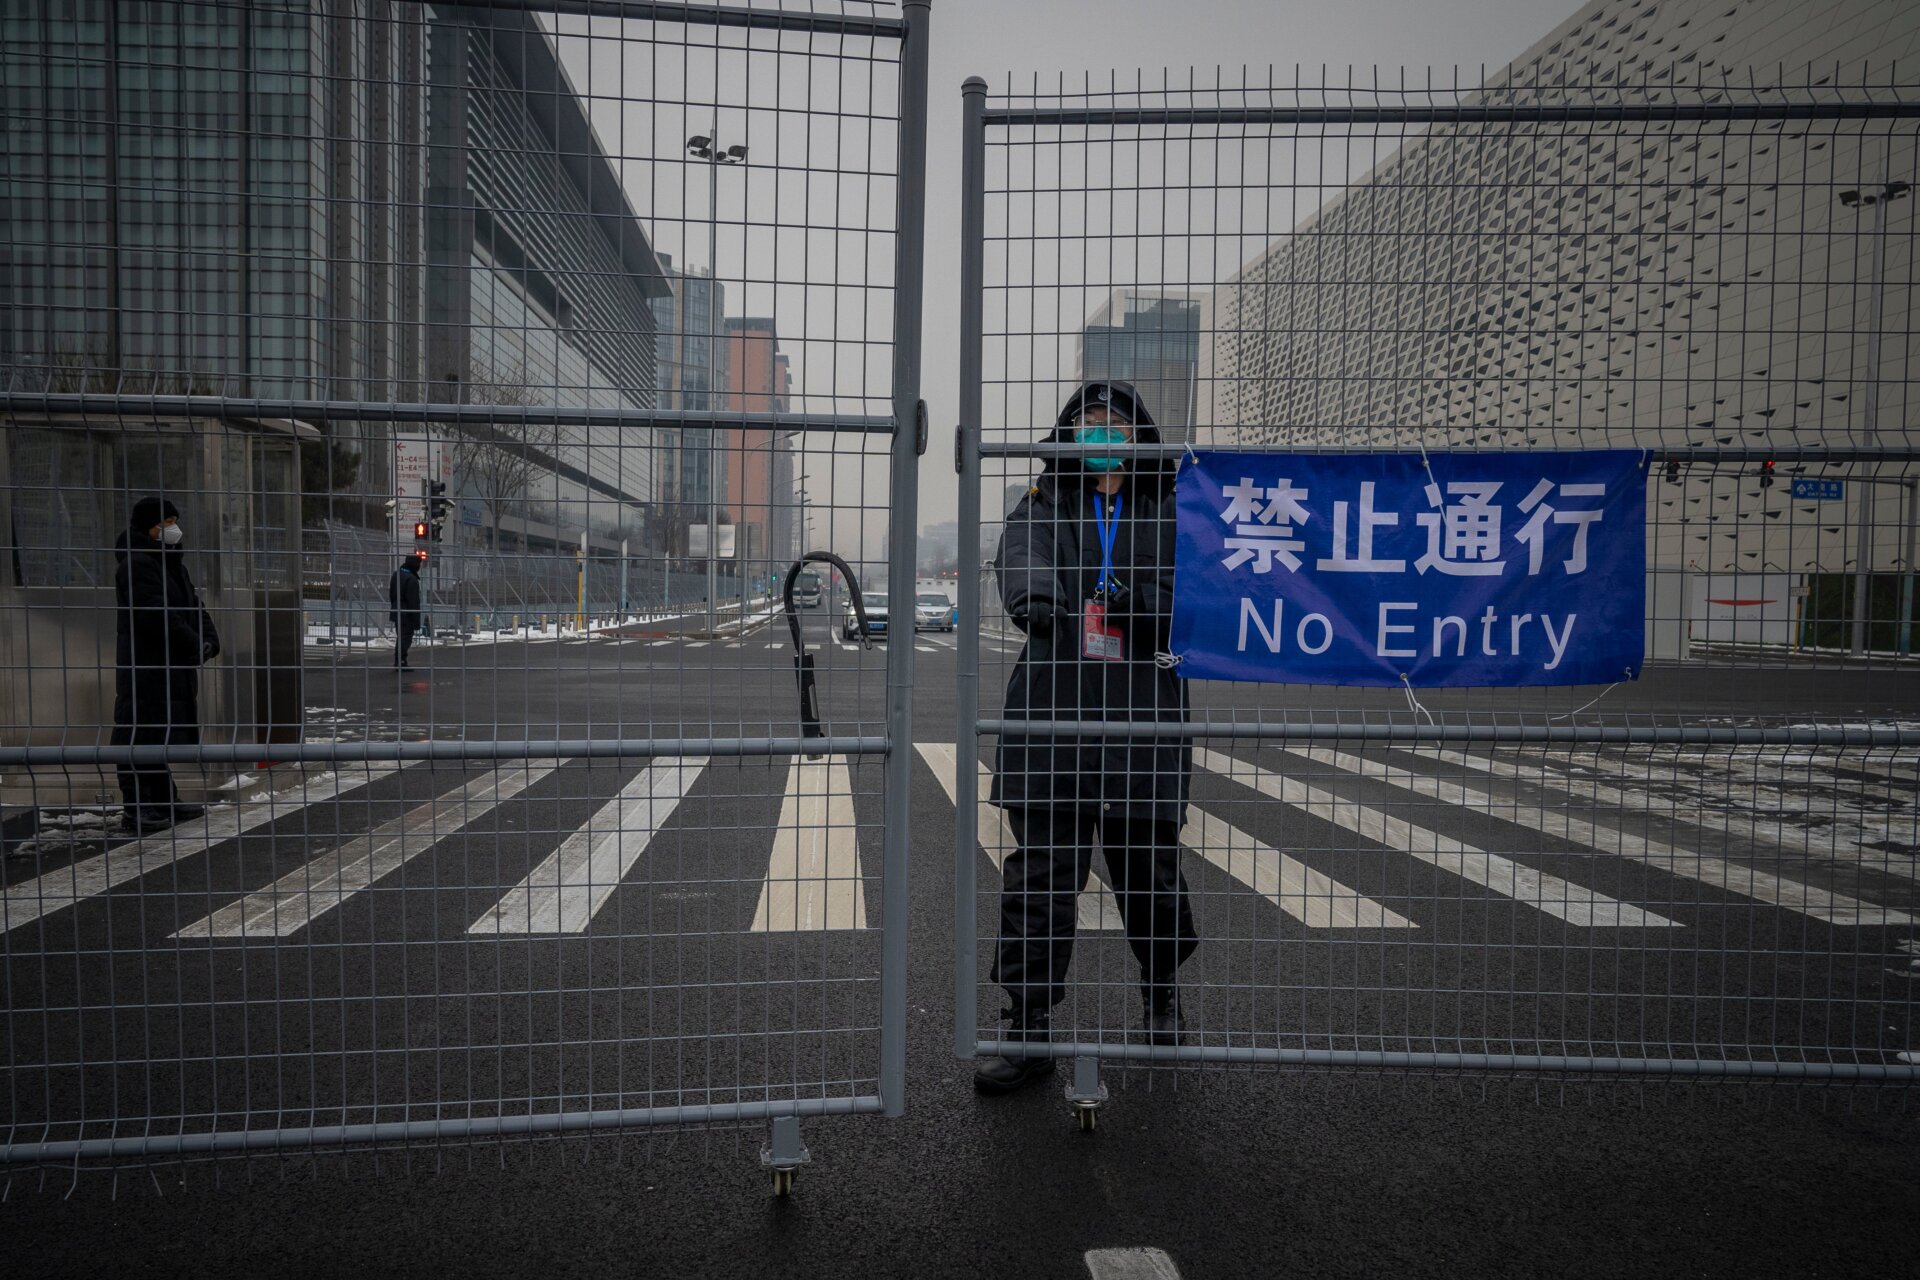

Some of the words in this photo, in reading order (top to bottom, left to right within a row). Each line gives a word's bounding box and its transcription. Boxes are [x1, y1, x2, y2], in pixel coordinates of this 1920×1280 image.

[1220, 477, 1606, 577] 禁止通行
[1237, 597, 1334, 655] No
[1377, 602, 1577, 670] Entry
